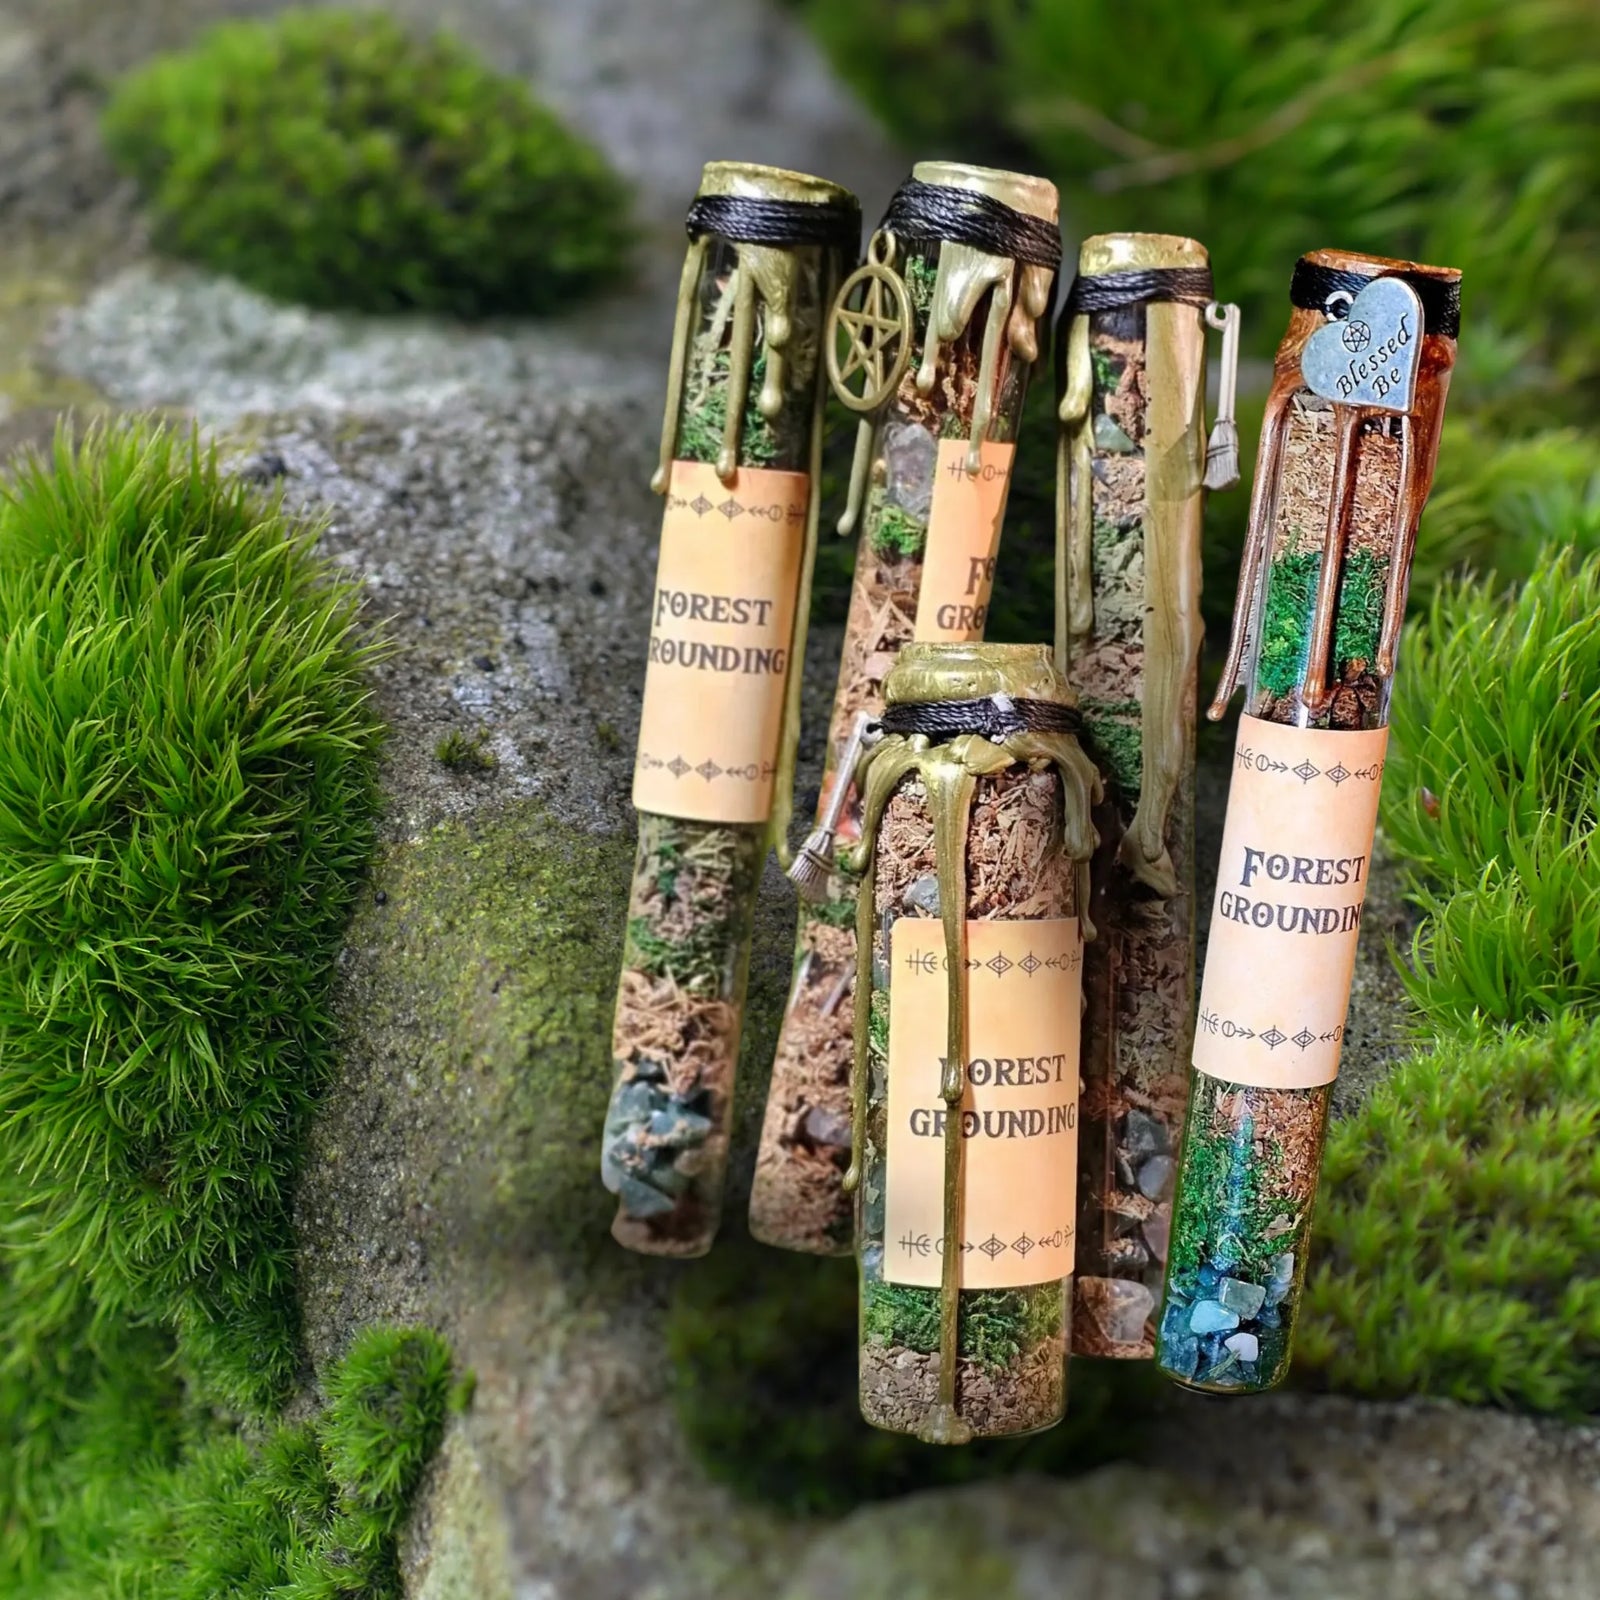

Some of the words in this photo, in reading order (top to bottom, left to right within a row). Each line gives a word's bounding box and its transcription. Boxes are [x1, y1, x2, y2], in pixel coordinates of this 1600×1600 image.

[1336, 312, 1413, 399] Blessed
[1372, 367, 1402, 399] Be
[655, 588, 773, 627] FOREST
[649, 636, 786, 675] ROUNDING
[1239, 846, 1366, 888] FOREST
[1220, 890, 1362, 935] GROUNDIN
